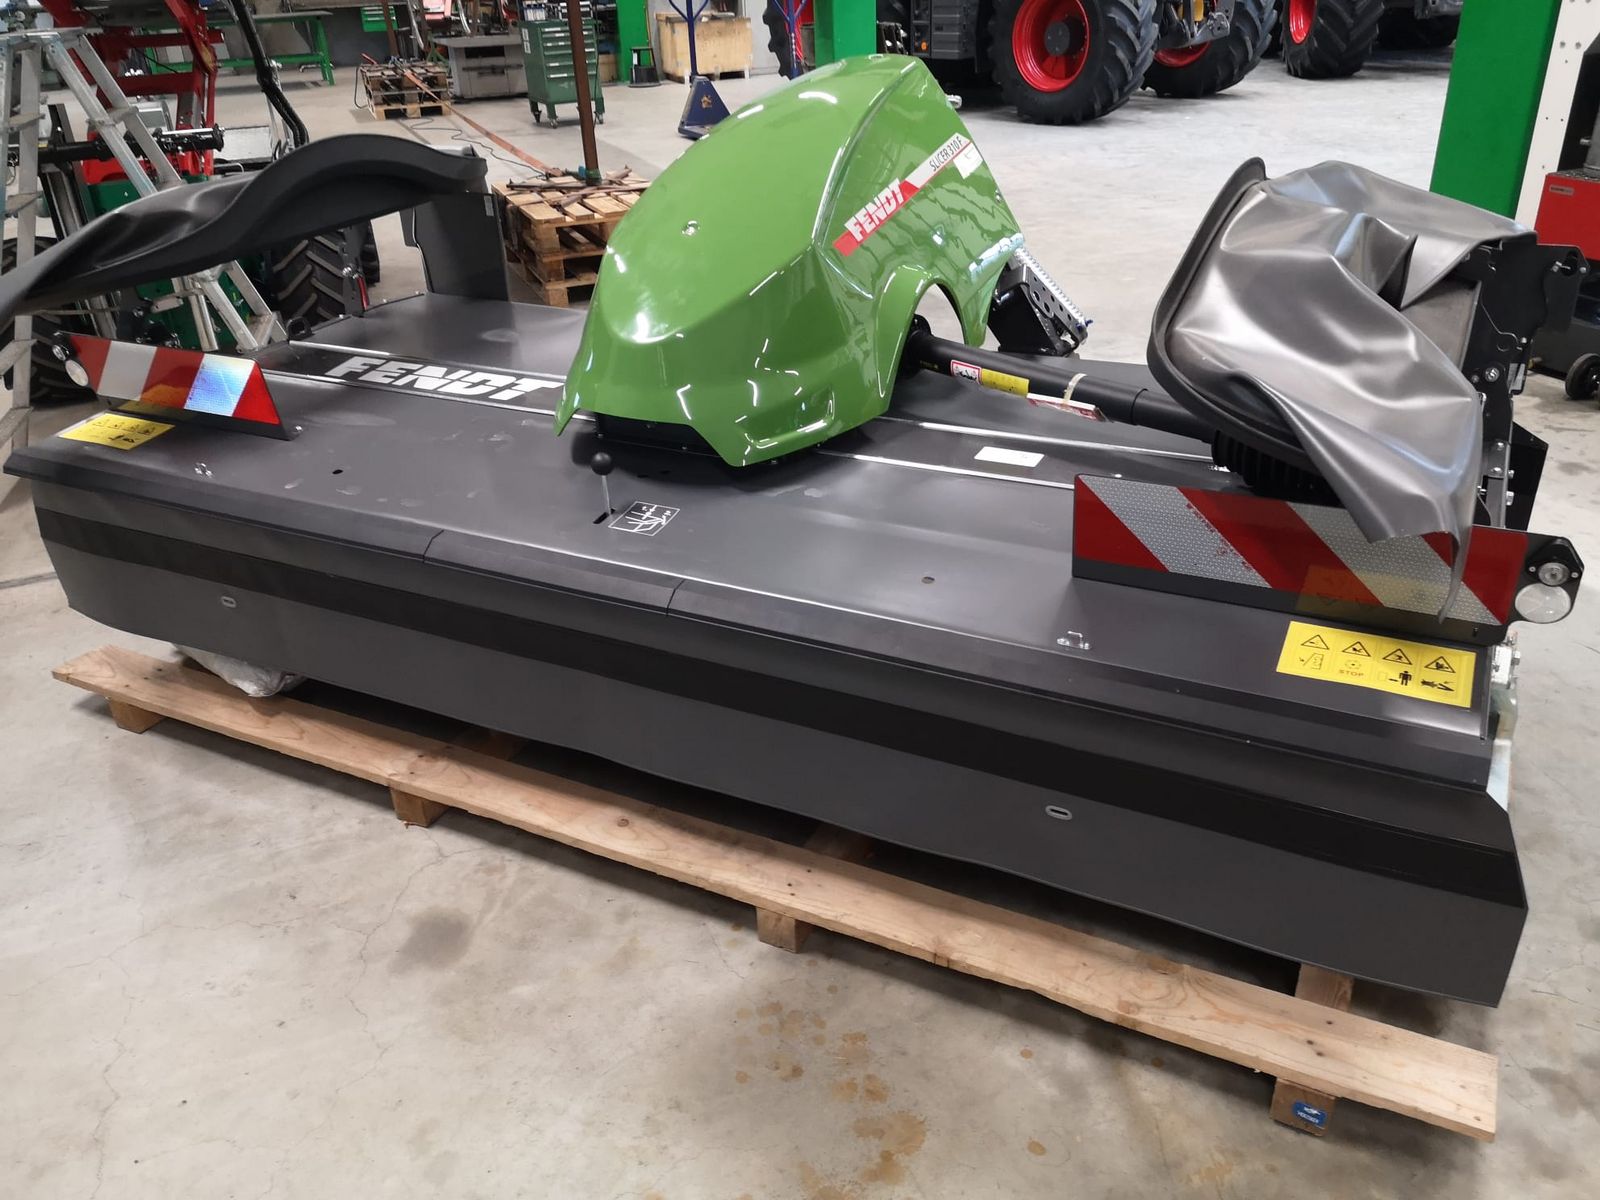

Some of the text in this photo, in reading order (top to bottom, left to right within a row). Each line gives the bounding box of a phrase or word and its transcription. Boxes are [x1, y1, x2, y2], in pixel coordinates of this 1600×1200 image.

[929, 148, 951, 172] SLICER
[947, 140, 960, 155] 310
[844, 178, 904, 242] FENDT
[325, 356, 565, 400] FENDT
[1339, 669, 1364, 677] STOP
